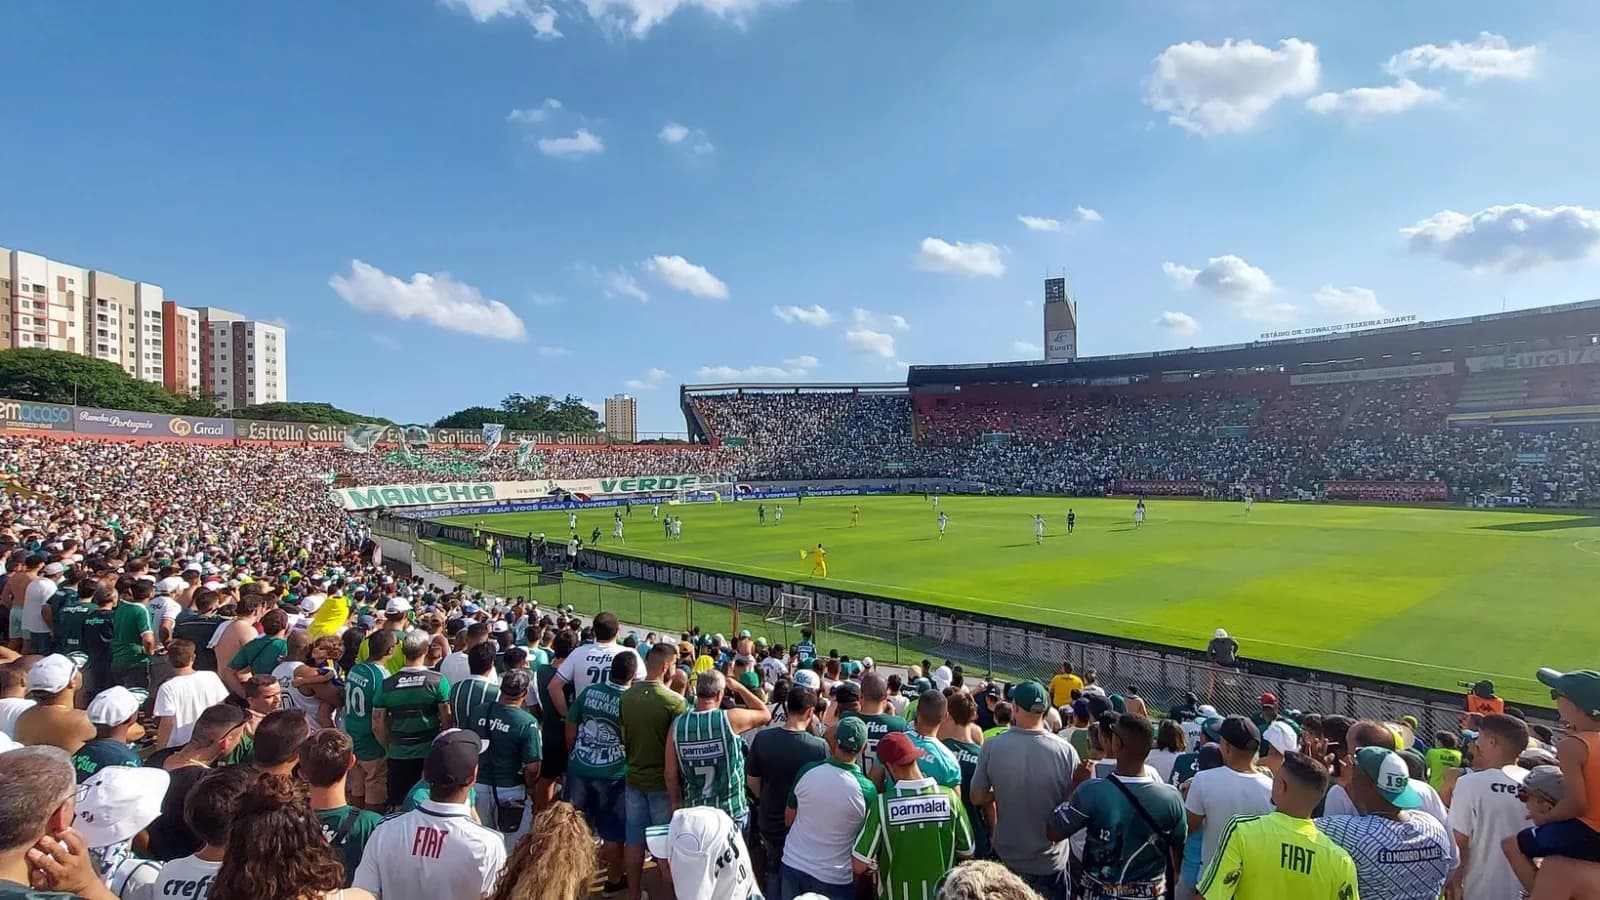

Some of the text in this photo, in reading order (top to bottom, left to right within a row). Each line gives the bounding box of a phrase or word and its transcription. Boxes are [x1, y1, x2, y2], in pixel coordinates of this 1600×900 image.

[1305, 324, 1342, 335] OSWALDO
[1347, 319, 1382, 330] TEIXEIRA
[1384, 314, 1417, 325] DUARTE
[1049, 343, 1073, 352] Euro17
[194, 422, 223, 435] Graal
[248, 422, 348, 442] Estrella Galici
[437, 430, 481, 444] Galicia
[556, 432, 596, 446] Galicia
[600, 475, 697, 493] VERDE
[349, 484, 495, 509] MANCHA
[586, 654, 612, 665] crefis
[398, 675, 426, 684] CASE
[682, 746, 721, 761] parmalat
[694, 766, 715, 798] 7
[890, 799, 947, 819] parmalat
[411, 826, 449, 859] FIAT
[1100, 828, 1111, 841] 12
[1281, 842, 1316, 875] FIAT
